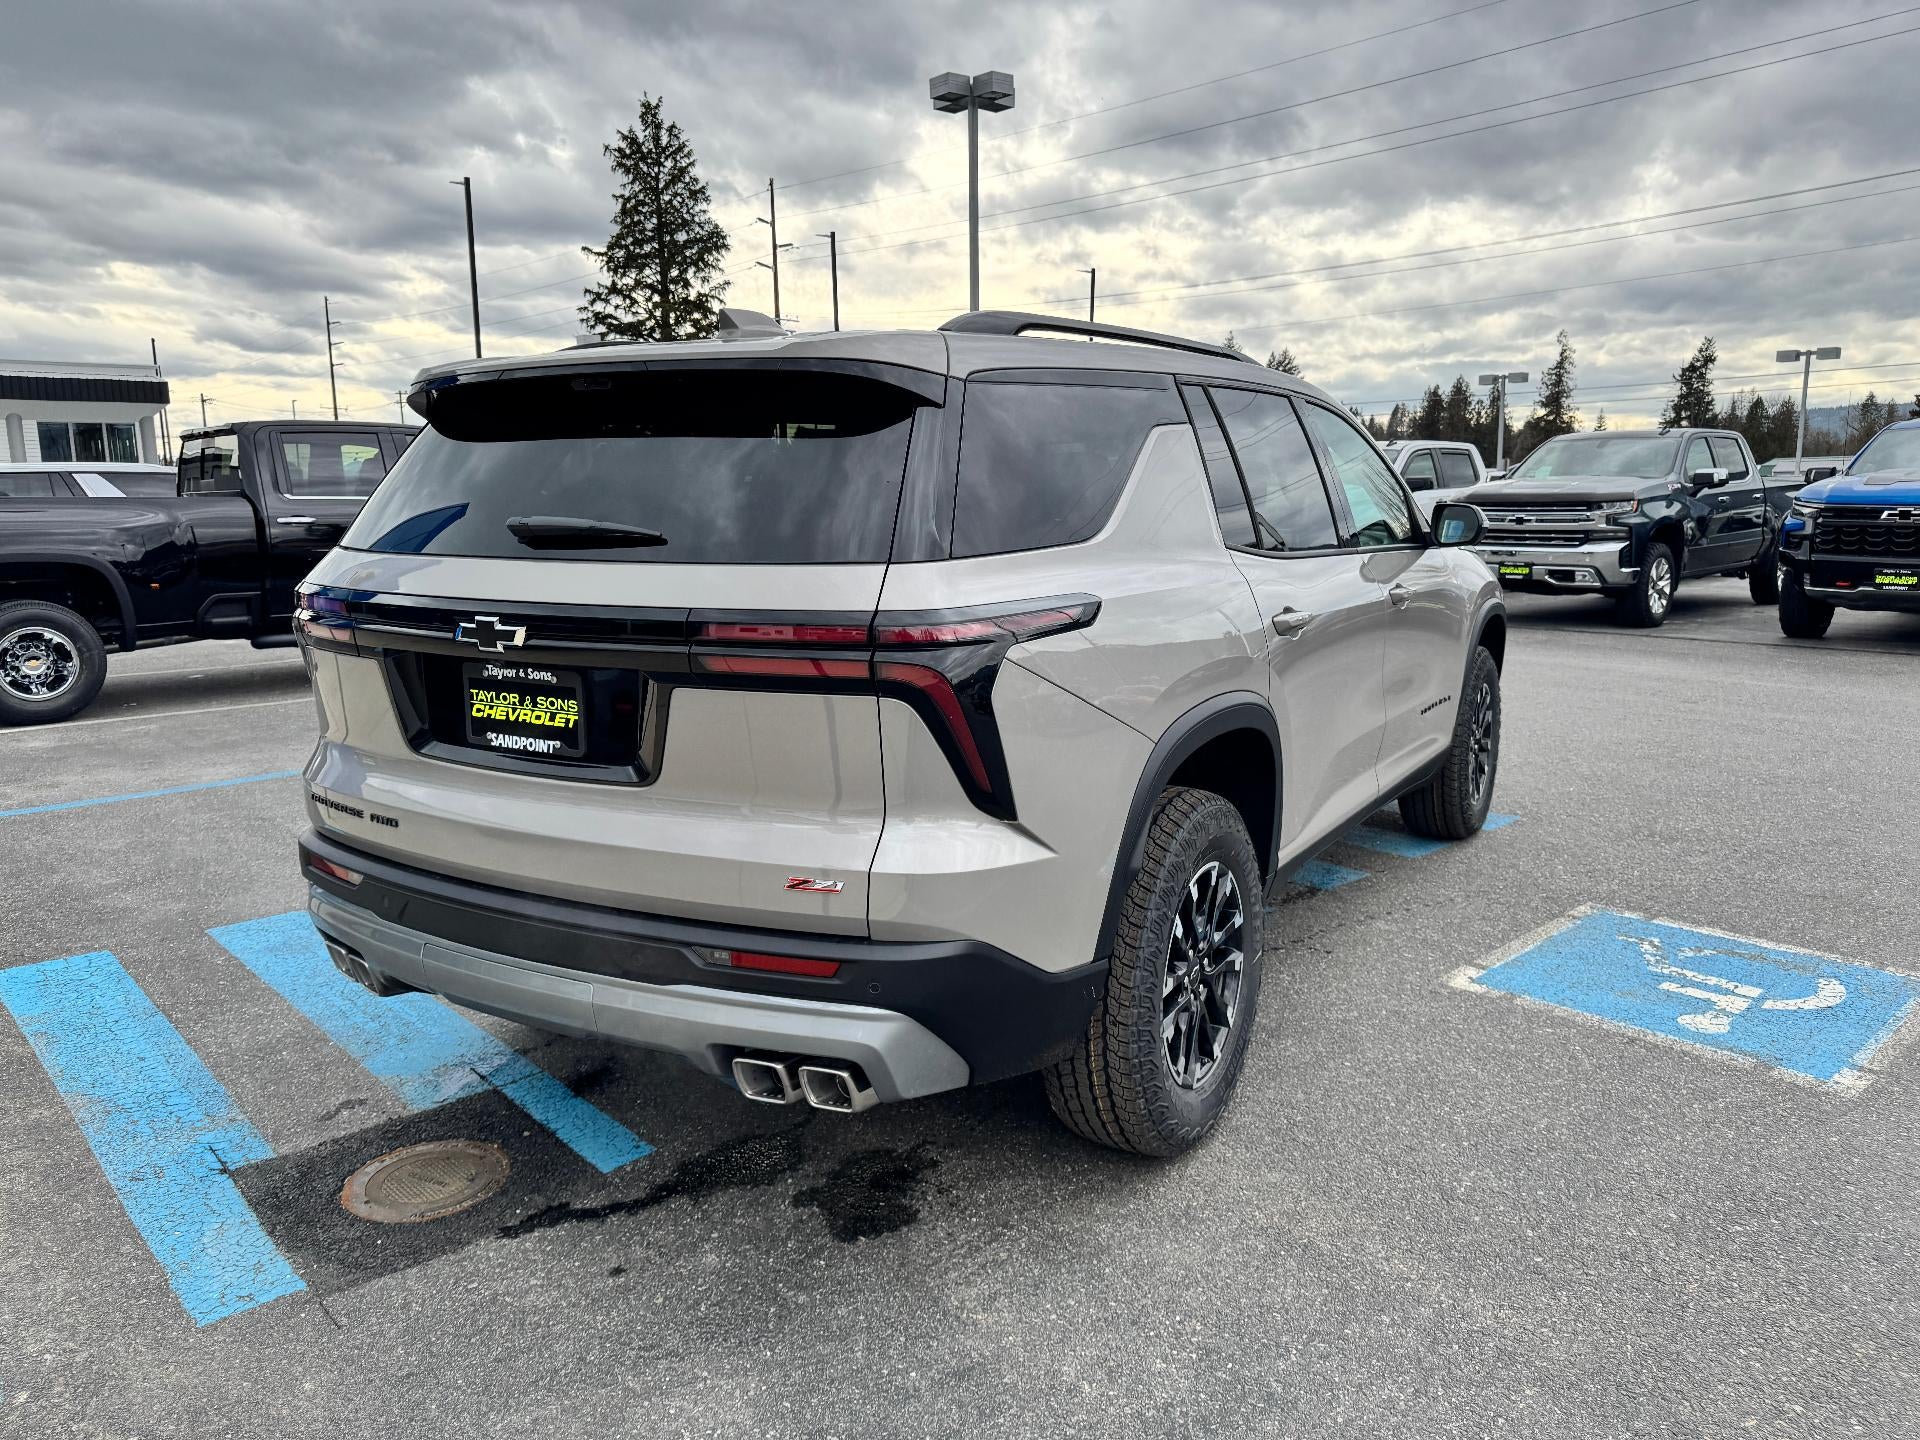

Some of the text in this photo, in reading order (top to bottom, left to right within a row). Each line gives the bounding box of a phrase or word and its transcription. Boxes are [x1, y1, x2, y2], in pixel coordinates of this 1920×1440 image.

[519, 668, 525, 677] &
[527, 668, 552, 681] Sons
[470, 689, 578, 712] TAYLOR & SONS
[471, 704, 579, 728] CHEVROLET
[490, 732, 558, 754] SANDPOINT
[784, 877, 845, 893] Z71
